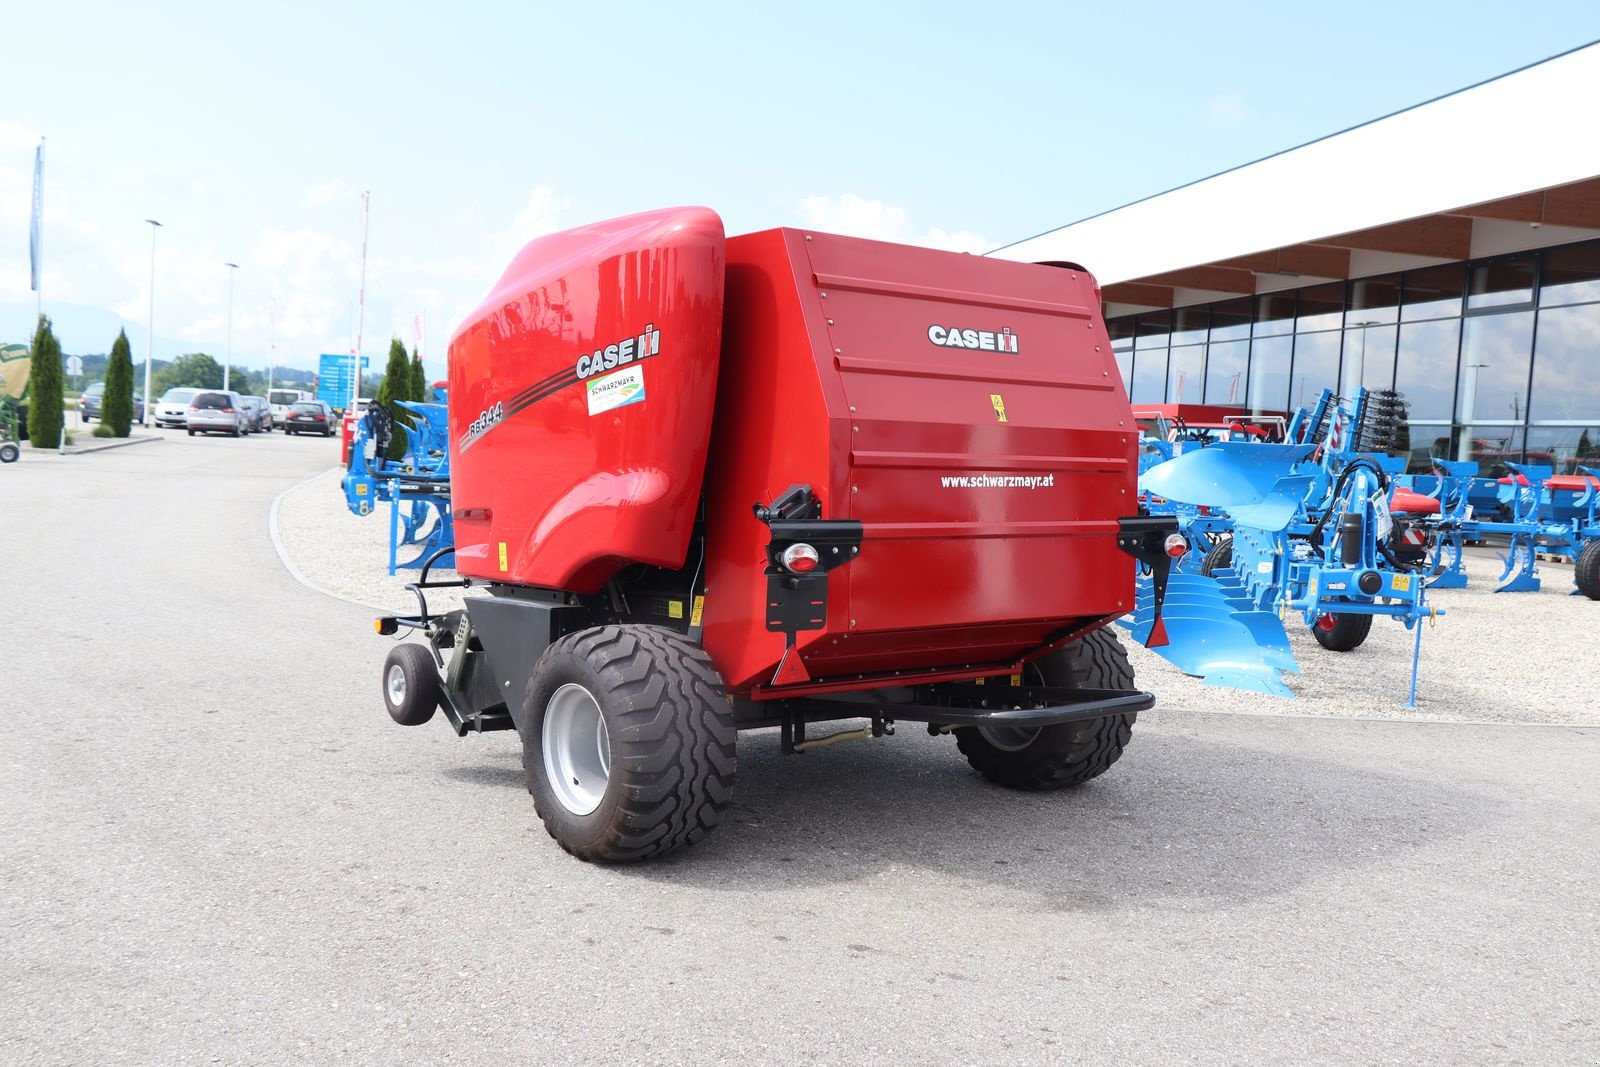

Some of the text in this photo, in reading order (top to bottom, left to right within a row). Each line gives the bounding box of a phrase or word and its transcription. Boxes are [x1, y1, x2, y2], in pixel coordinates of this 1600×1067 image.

[928, 325, 995, 350] CASE
[576, 338, 634, 379] CASE
[591, 376, 635, 396] SCHWARZMAYR
[469, 401, 502, 437] RB344
[941, 473, 1054, 490] www.schwarzmayr.at
